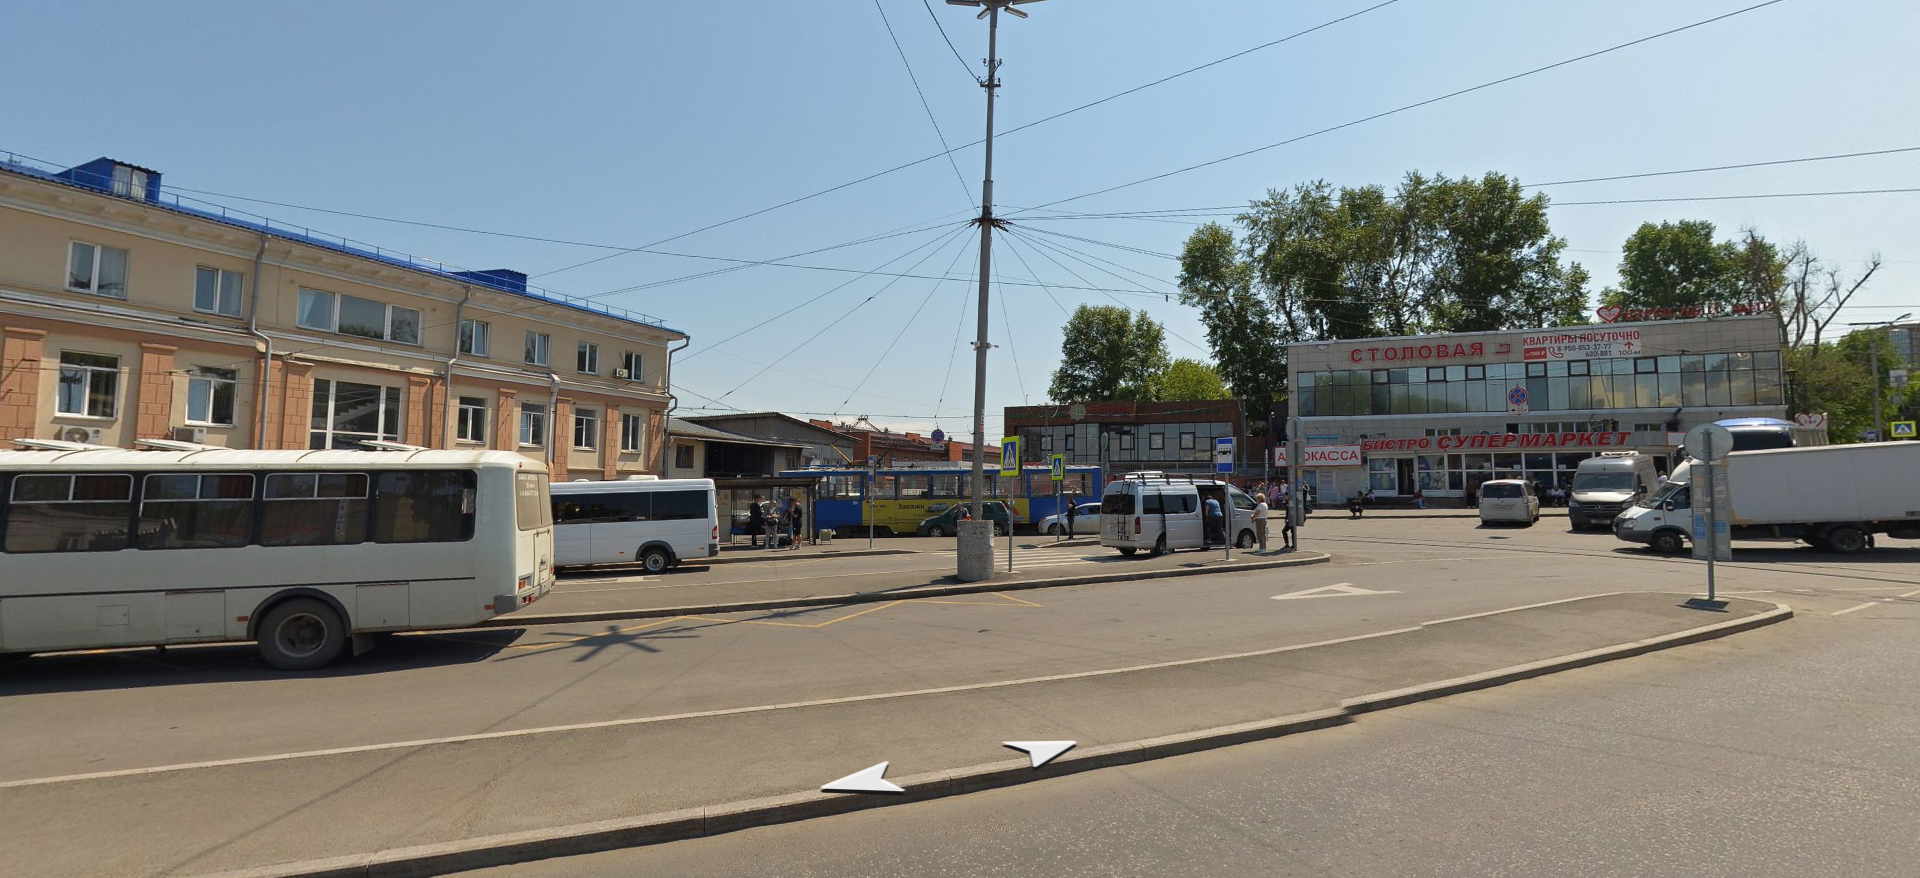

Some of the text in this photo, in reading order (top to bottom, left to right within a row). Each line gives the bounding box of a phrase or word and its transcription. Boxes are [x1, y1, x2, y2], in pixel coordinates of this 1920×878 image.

[1522, 331, 1640, 346] КВАРТИРЫ ПОСУТОЧНО
[1350, 342, 1484, 363] СТОЛОВАЯ
[1362, 432, 1632, 451] БИСТРО СУПЕРМАРКЕТ
[897, 502, 925, 510] Закажи
